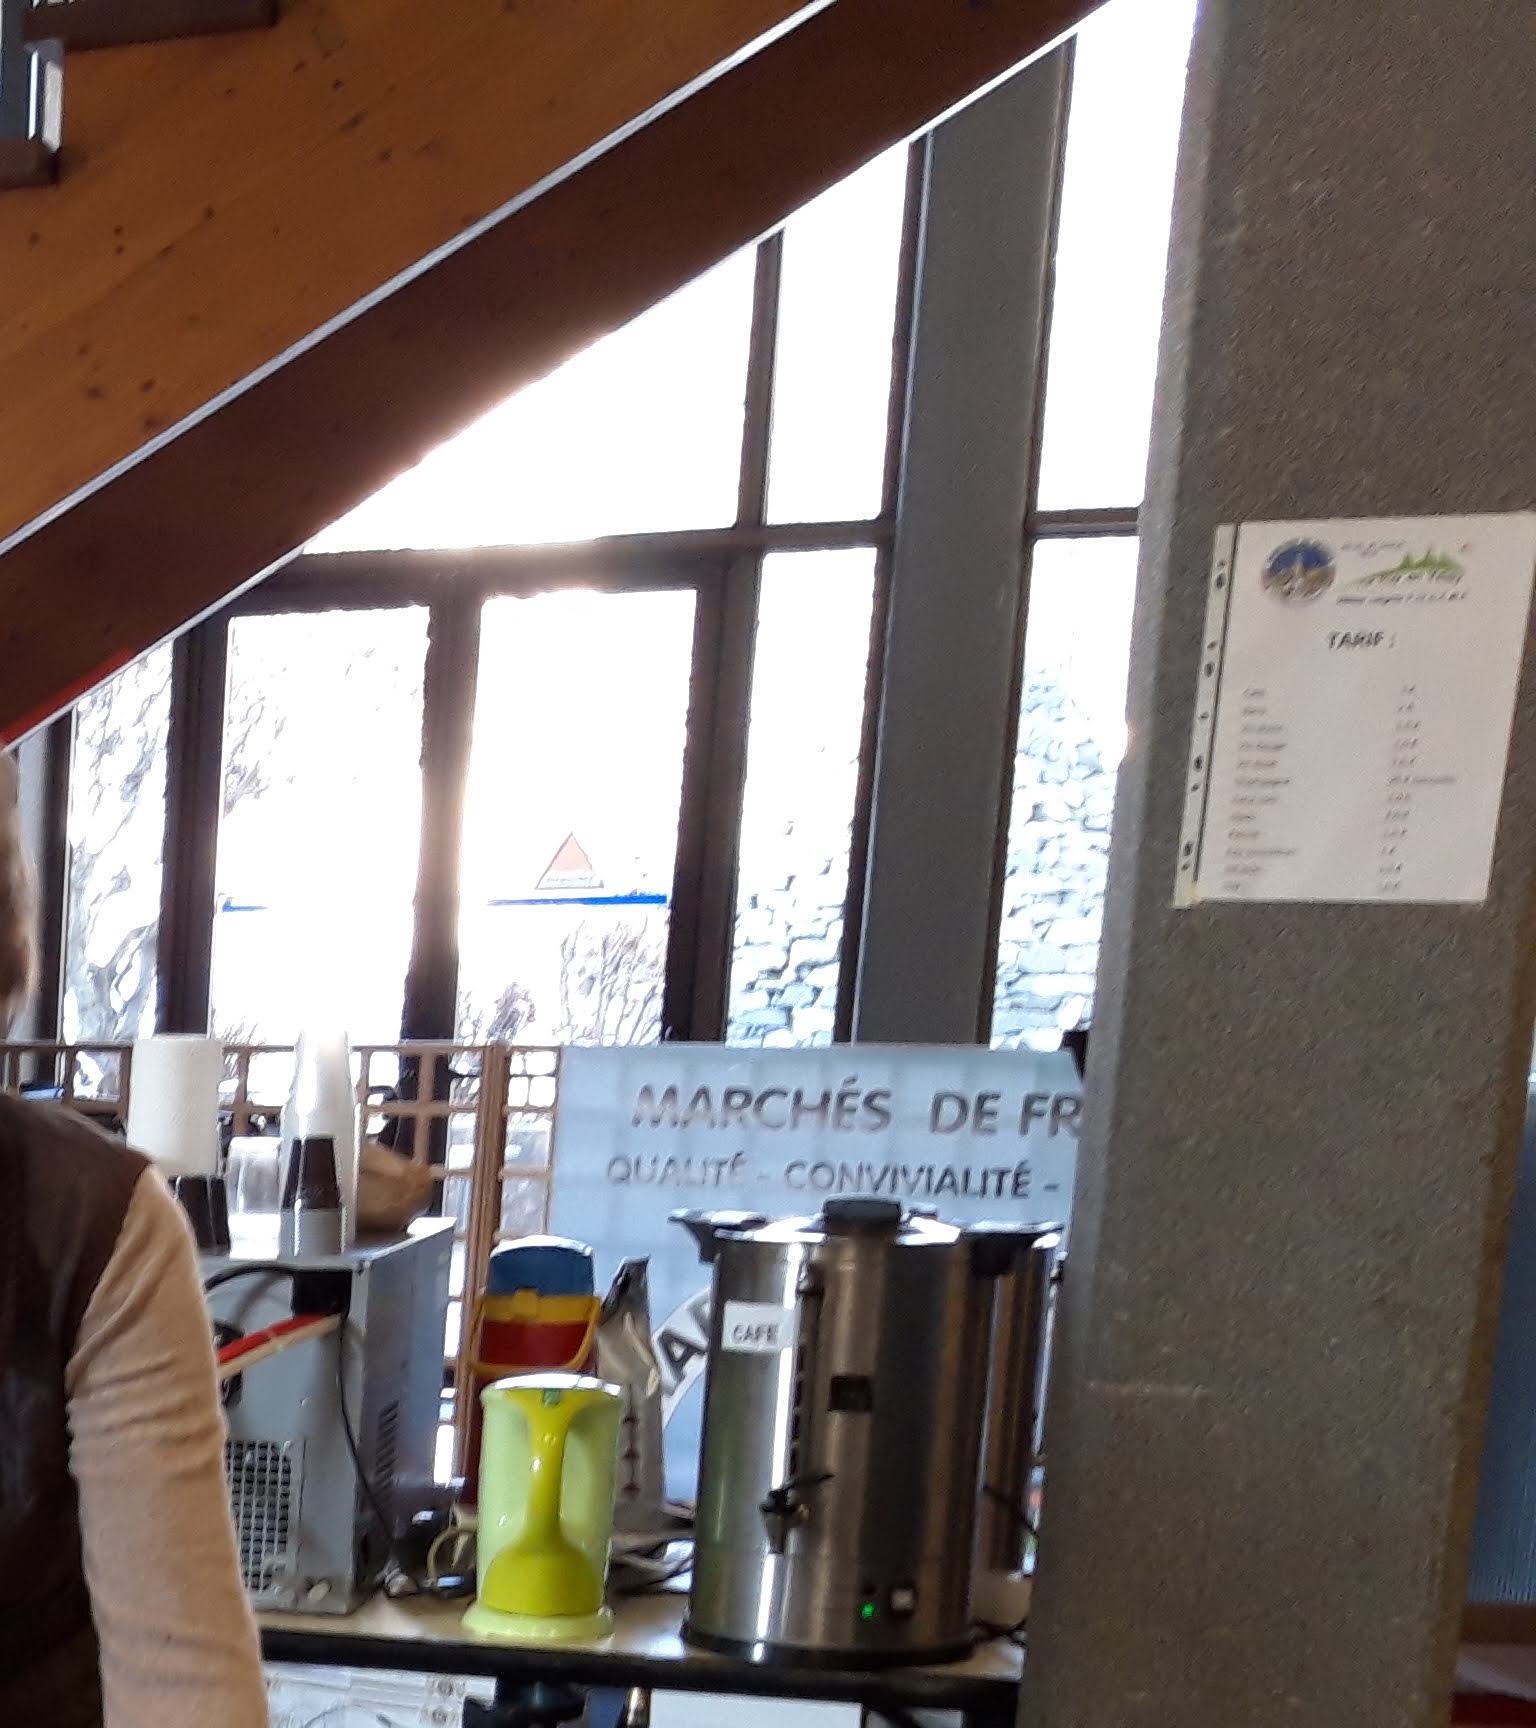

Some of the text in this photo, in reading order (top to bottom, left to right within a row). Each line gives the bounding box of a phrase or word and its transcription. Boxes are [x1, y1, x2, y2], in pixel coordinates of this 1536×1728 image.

[631, 1075, 892, 1132] MARCHÉS
[929, 1089, 1002, 1137] DE
[606, 1150, 745, 1189] QUALITÉ
[783, 1158, 1033, 1199] CONVIVIALITÉ
